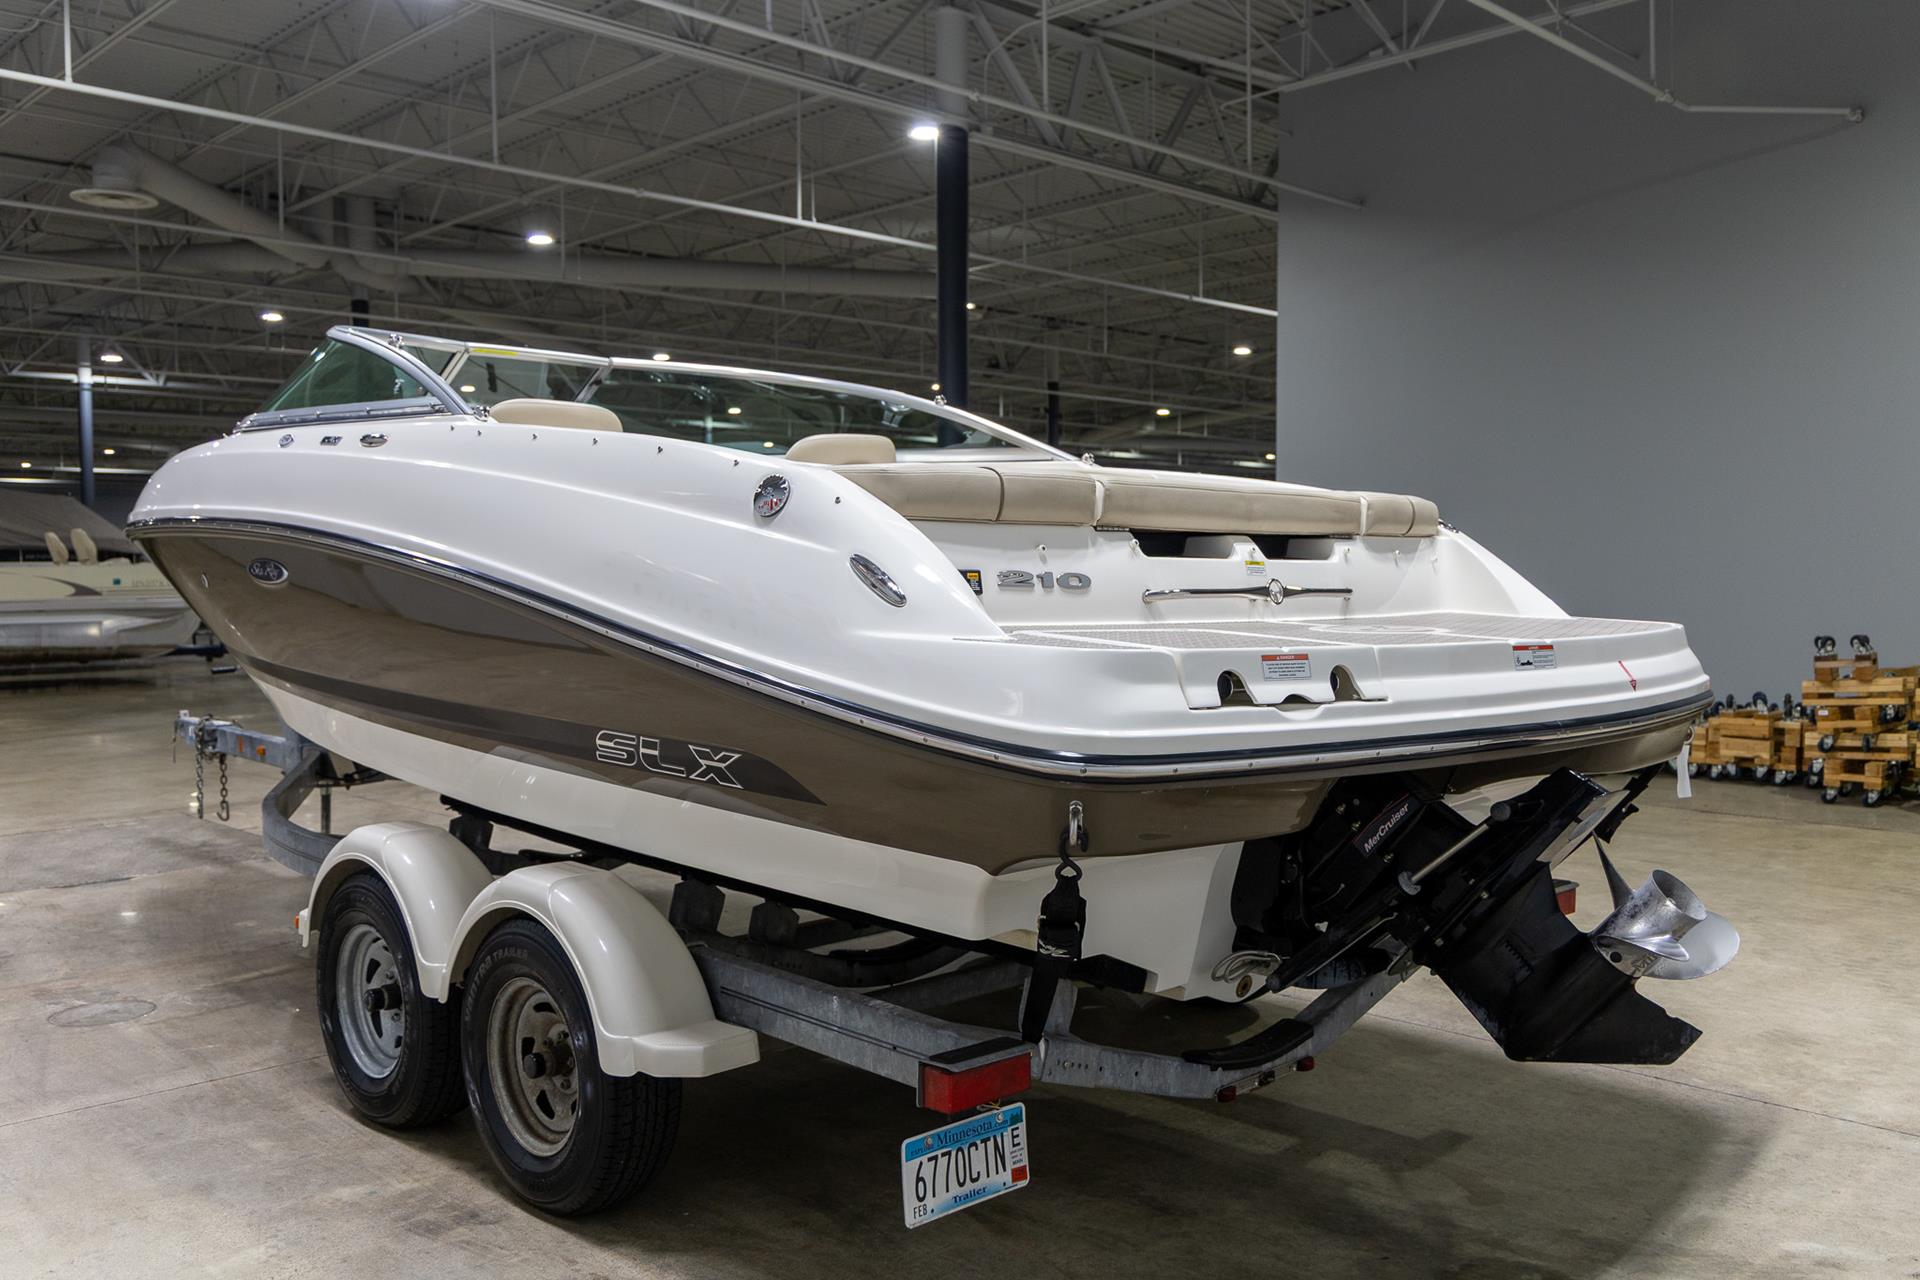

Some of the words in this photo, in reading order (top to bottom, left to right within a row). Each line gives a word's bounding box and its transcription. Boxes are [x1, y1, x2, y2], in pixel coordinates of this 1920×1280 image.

[997, 570, 1092, 590] 210
[595, 729, 744, 789] SLX
[1363, 803, 1409, 853] MerCruiser
[1011, 1126, 1021, 1148] E
[915, 1133, 1007, 1203] 6770CTN
[952, 1186, 988, 1204] Trailer
[913, 1203, 928, 1219] FEB
